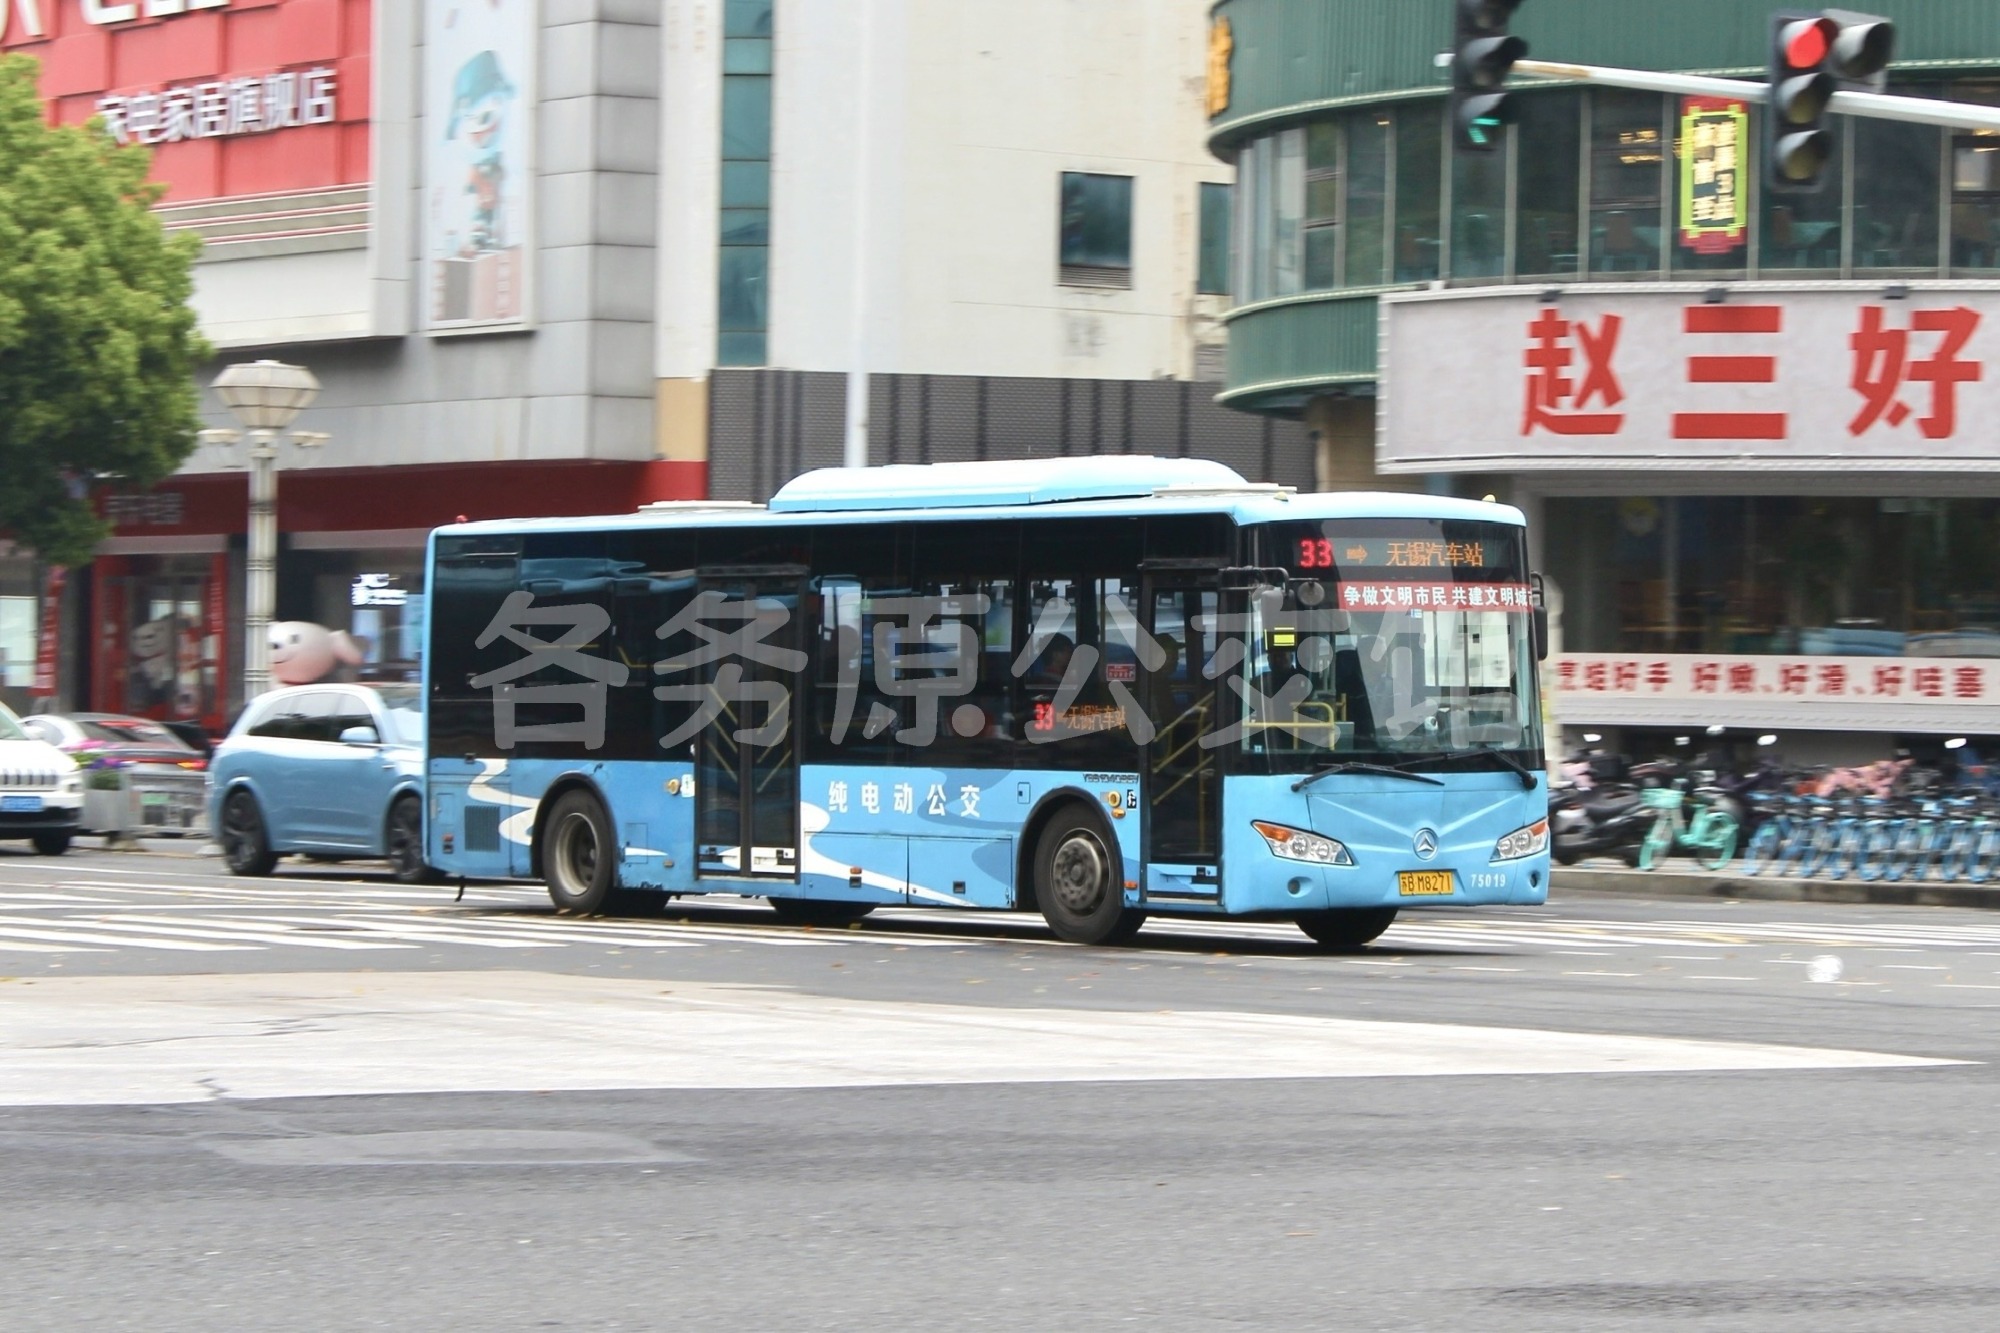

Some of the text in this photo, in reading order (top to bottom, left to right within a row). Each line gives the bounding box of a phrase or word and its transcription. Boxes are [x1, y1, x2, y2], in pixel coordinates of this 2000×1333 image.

[95, 67, 336, 143] 家电家居旗舰店
[1520, 304, 1983, 440] 赵三好
[1300, 539, 1484, 568] 33 无锡汽车站
[1344, 585, 1447, 606] 争做文明市民
[1033, 703, 1127, 731] 33 无锡汽车站
[828, 780, 981, 818] 纯电动公交
[1471, 873, 1506, 888] 75019
